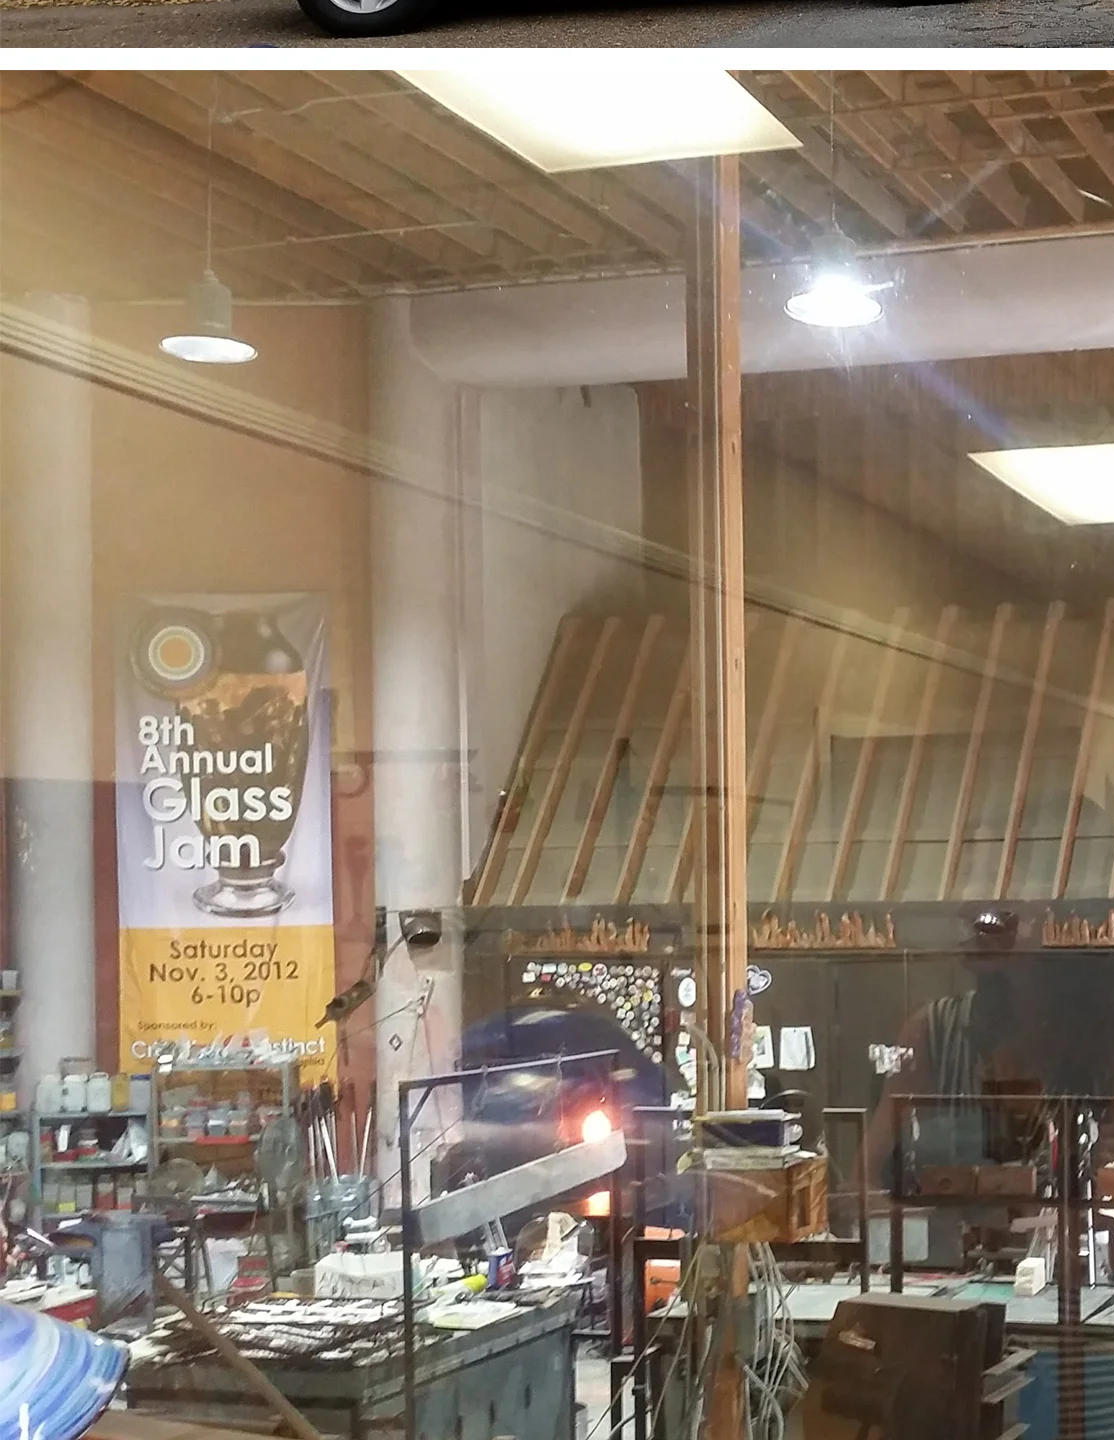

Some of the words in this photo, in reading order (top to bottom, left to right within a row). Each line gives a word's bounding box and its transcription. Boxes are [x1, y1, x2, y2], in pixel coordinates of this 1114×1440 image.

[138, 715, 195, 746] 8th
[140, 742, 274, 775] Annual
[142, 776, 293, 823] Glass
[142, 824, 261, 870] Jam
[170, 939, 279, 962] Saturday
[149, 962, 206, 982] Nov.
[214, 962, 236, 984] 3,
[243, 960, 299, 981] 2012
[191, 984, 262, 1008] 6-10p
[138, 1020, 197, 1031] Sponsored
[200, 1019, 217, 1032] by:
